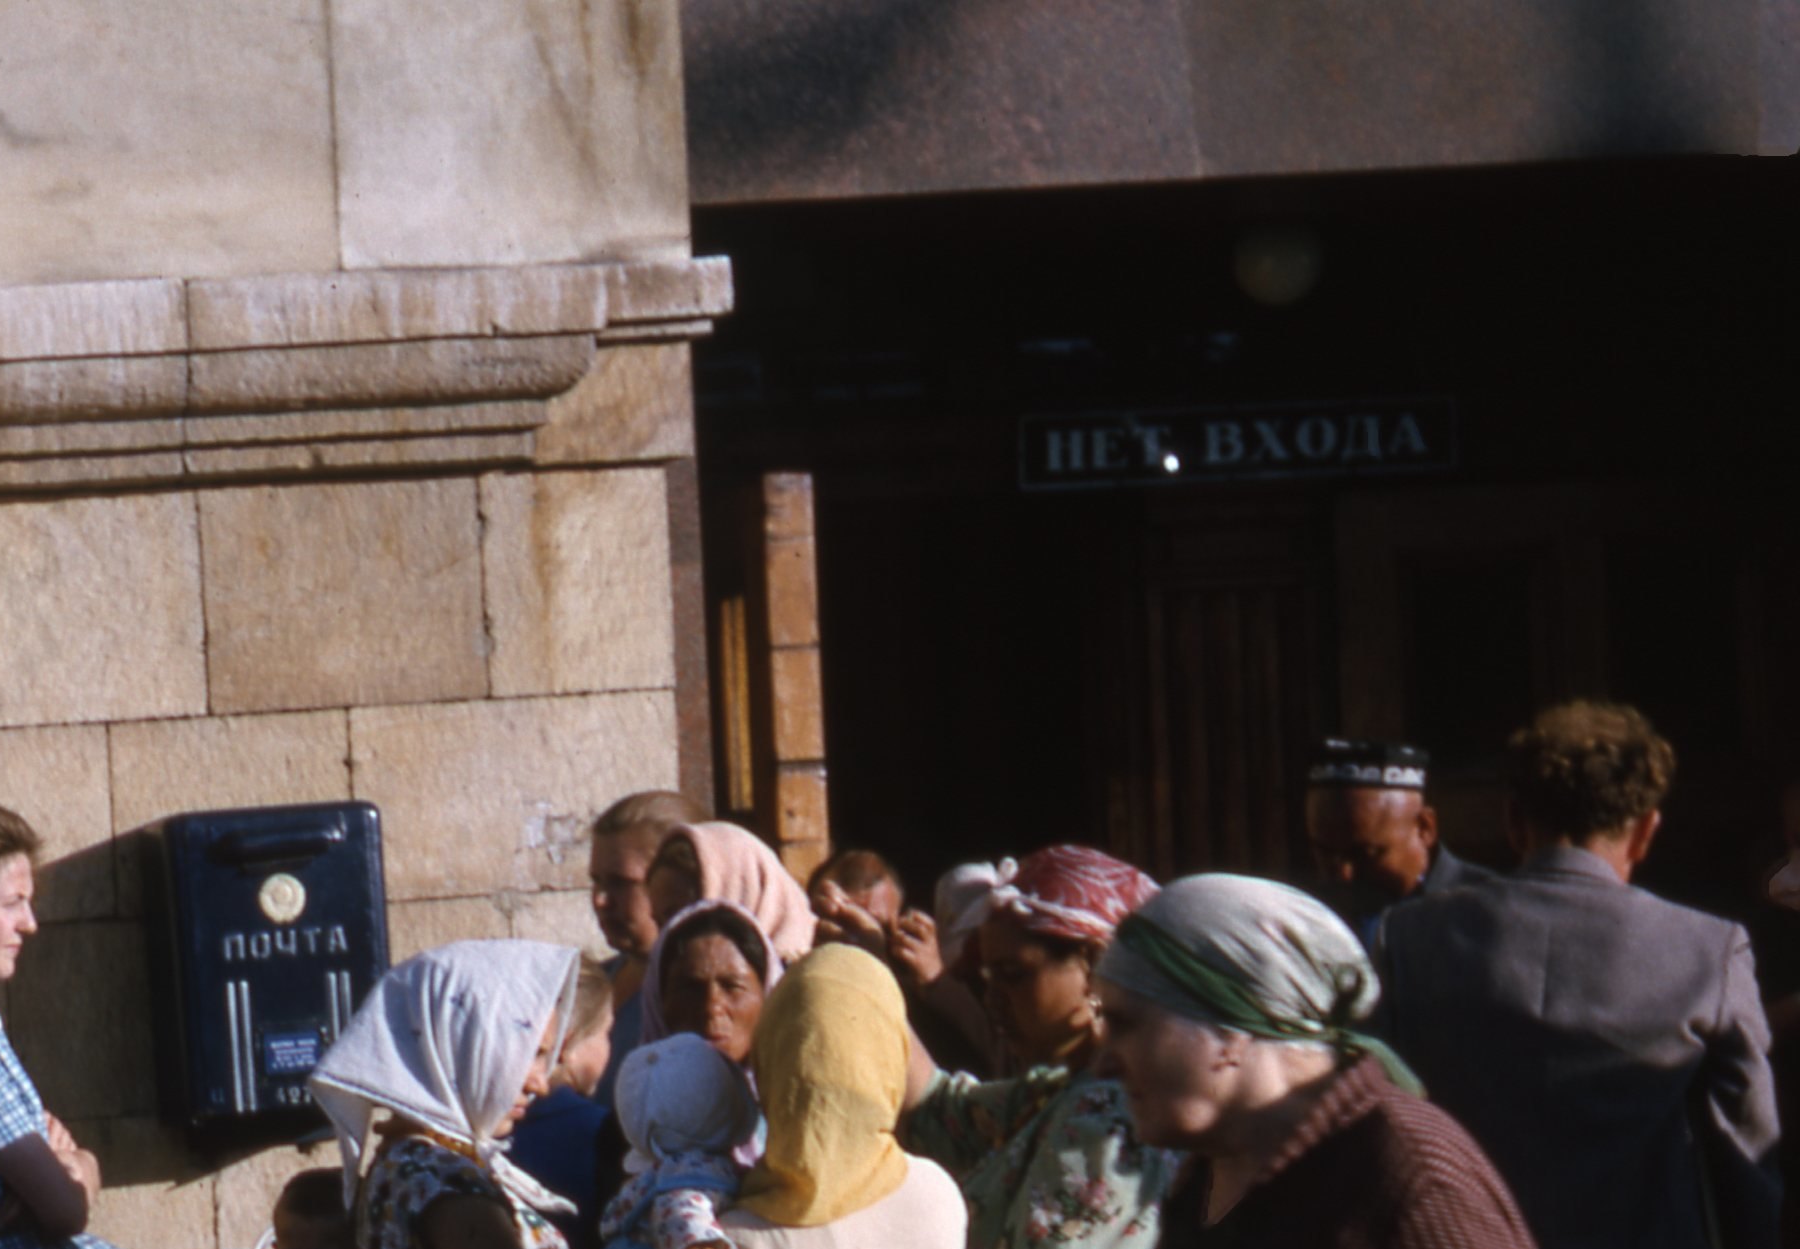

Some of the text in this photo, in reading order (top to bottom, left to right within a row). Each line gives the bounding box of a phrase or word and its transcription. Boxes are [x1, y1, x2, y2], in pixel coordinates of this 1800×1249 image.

[1045, 411, 1428, 473] НЕТ ВХОДА
[222, 924, 349, 962] ПОЧТА
